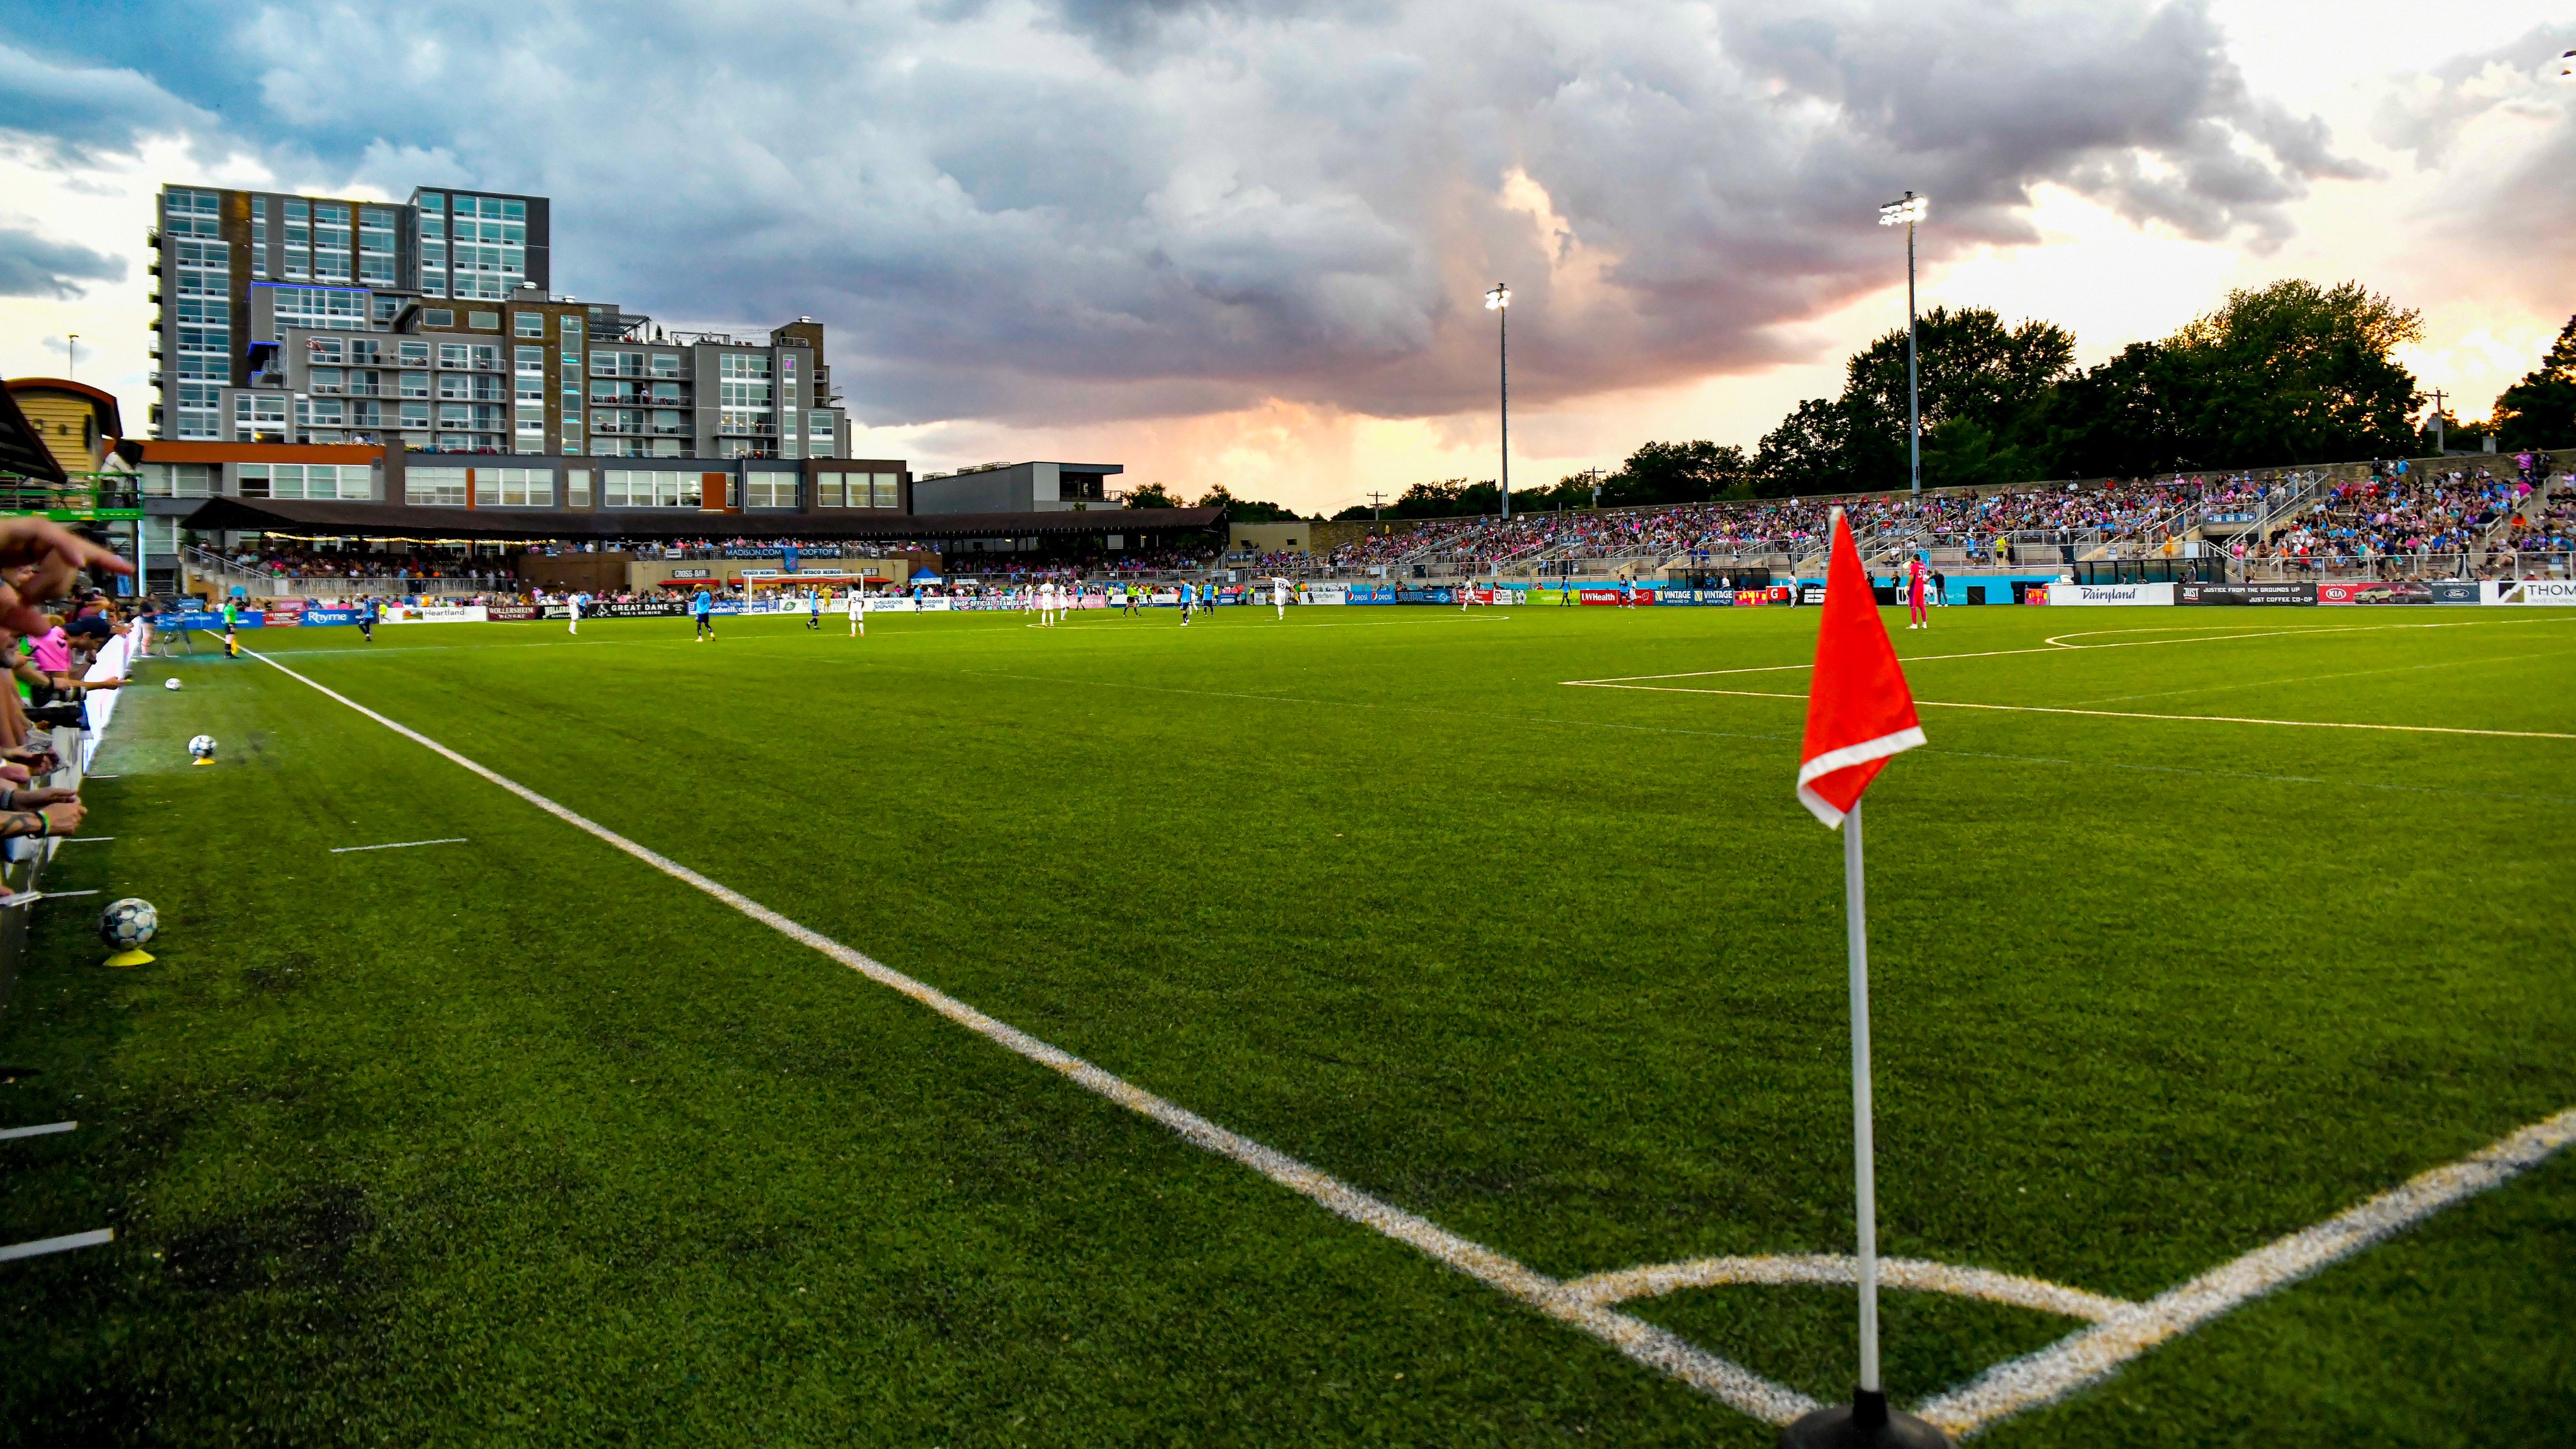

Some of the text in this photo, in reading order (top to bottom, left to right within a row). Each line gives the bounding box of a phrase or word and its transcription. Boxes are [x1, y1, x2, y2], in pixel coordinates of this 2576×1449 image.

[694, 569, 706, 577] BAR
[1354, 592, 1392, 602] pepsi pepsi
[1664, 591, 1691, 599] VINTAGE
[1704, 591, 1733, 599] VINTAGE
[1770, 588, 1779, 599] G
[2080, 587, 2136, 603] Dairyland
[2183, 587, 2199, 597] JUST
[425, 608, 465, 616] Heartland
[308, 611, 347, 624] Rhyme
